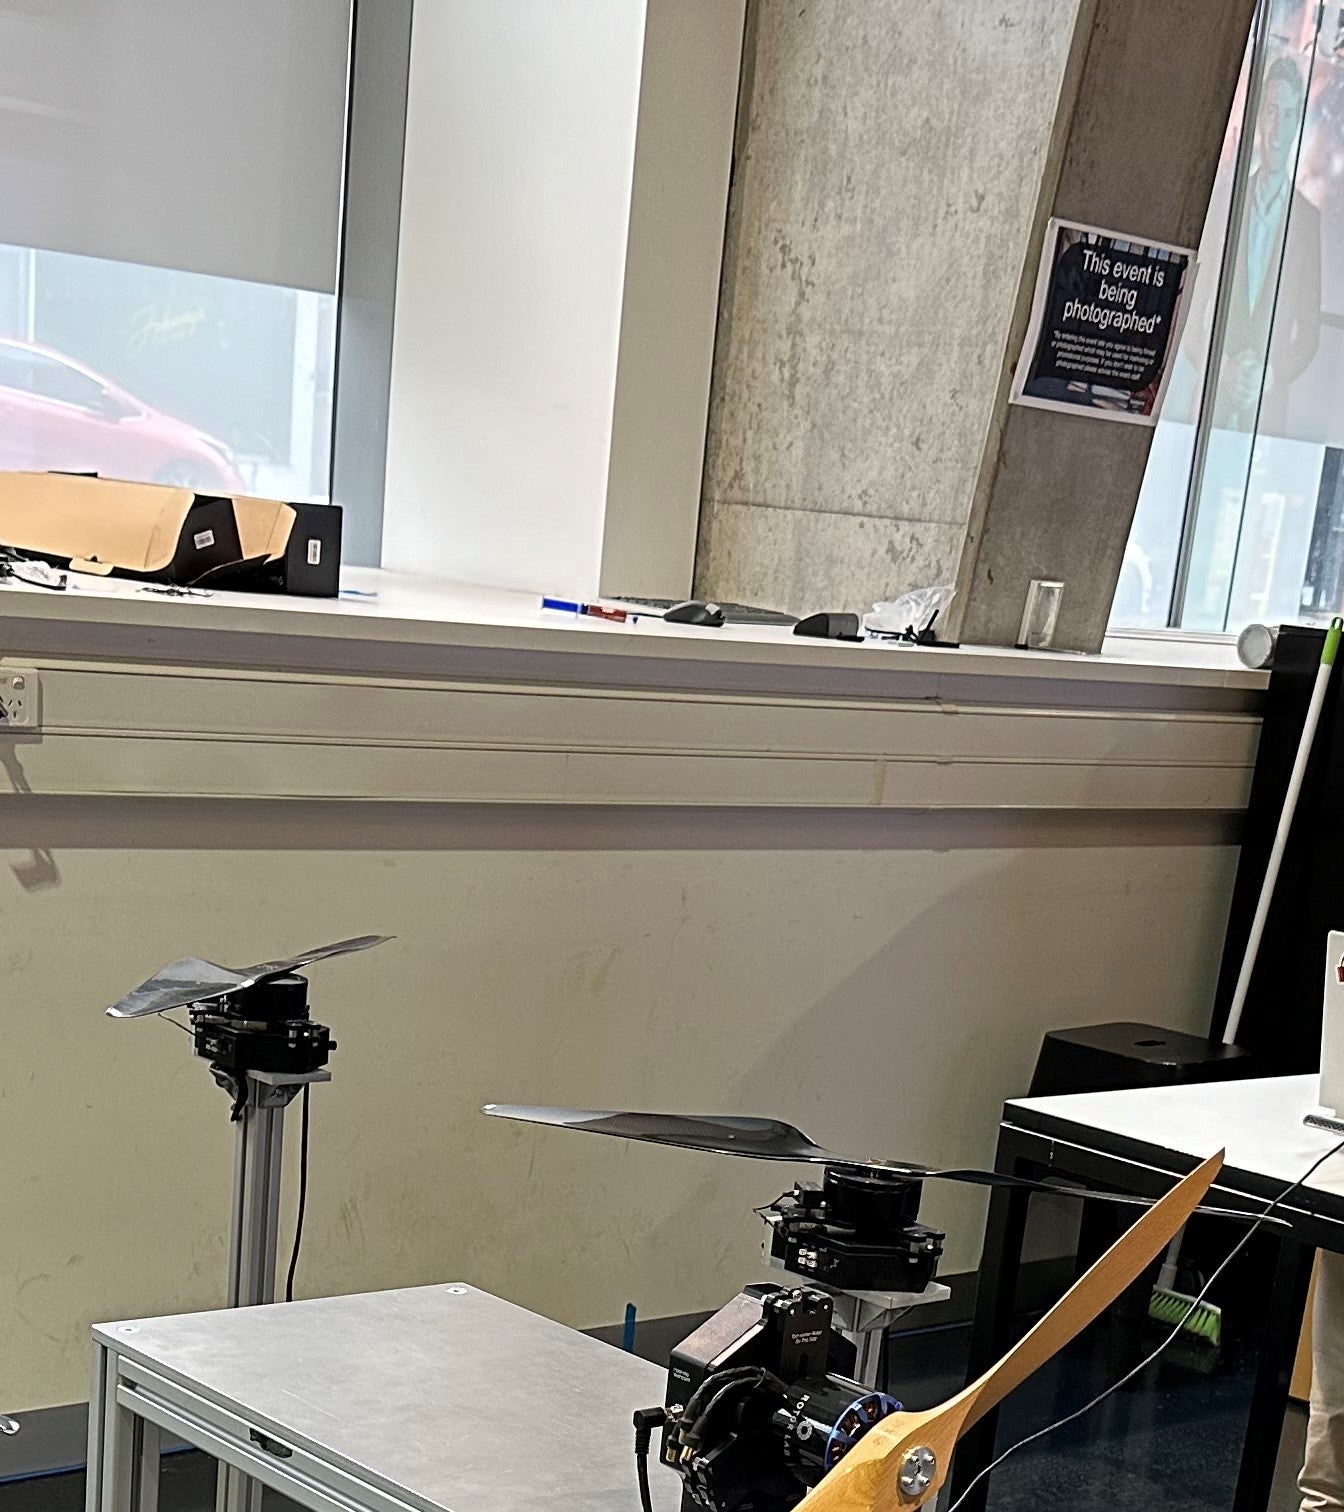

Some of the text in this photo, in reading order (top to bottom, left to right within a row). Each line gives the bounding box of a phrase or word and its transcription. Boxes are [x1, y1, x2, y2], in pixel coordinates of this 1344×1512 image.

[1083, 249, 1165, 287] This event is
[1098, 279, 1138, 310] being
[787, 1394, 810, 1431] ROTOR
